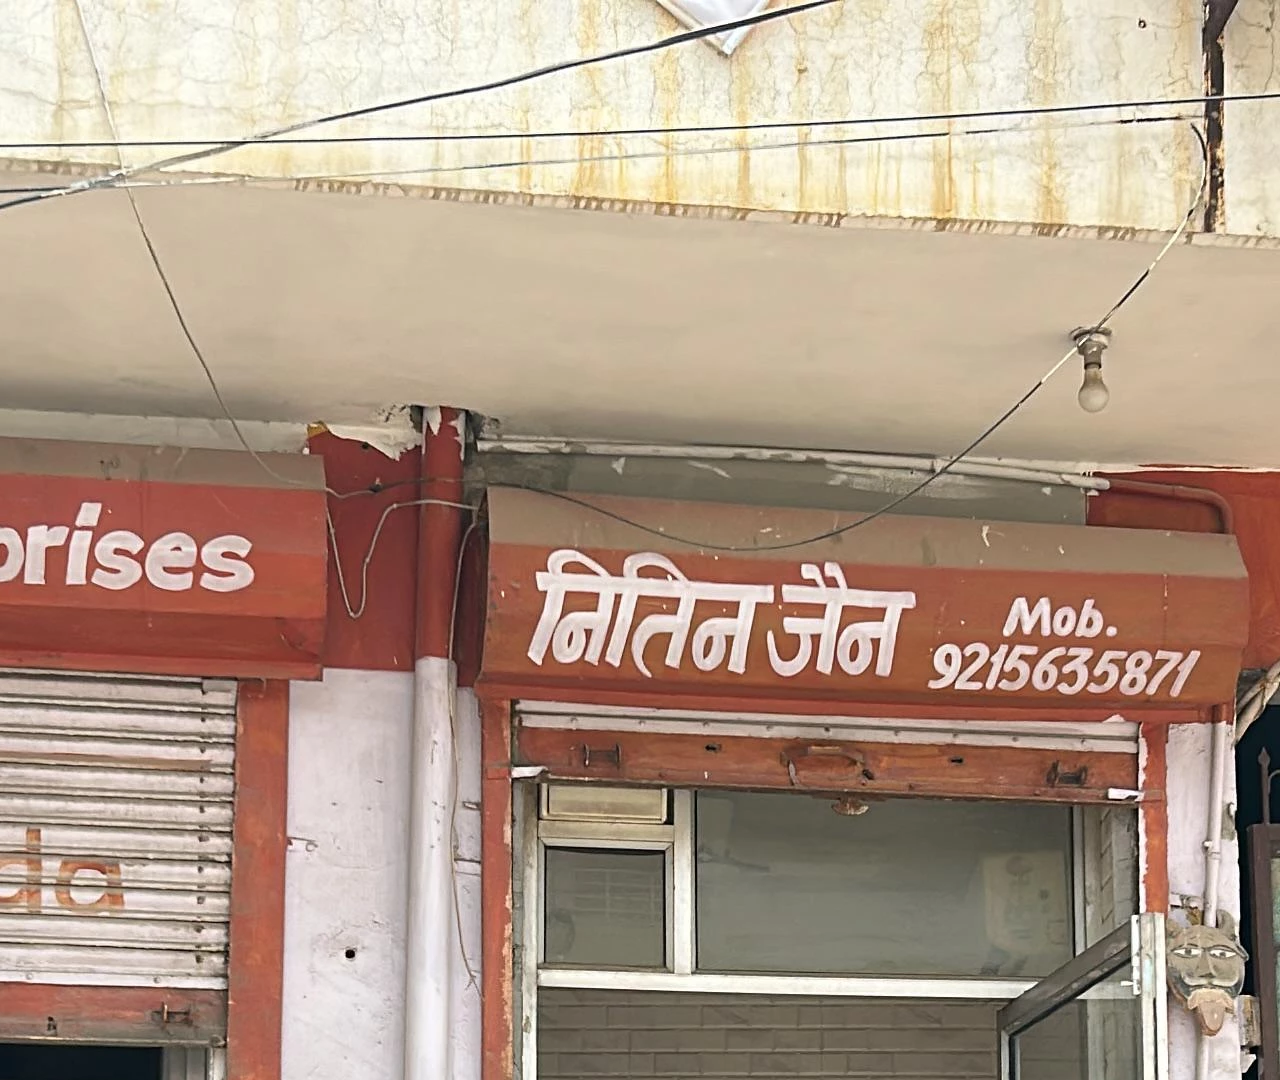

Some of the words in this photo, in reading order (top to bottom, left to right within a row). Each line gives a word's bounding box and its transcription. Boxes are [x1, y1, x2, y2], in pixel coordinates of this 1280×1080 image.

[527, 548, 775, 678] नितिन
[766, 561, 917, 677] जैन
[1002, 596, 1119, 638] Mob.
[927, 642, 1201, 698] 9215635871
